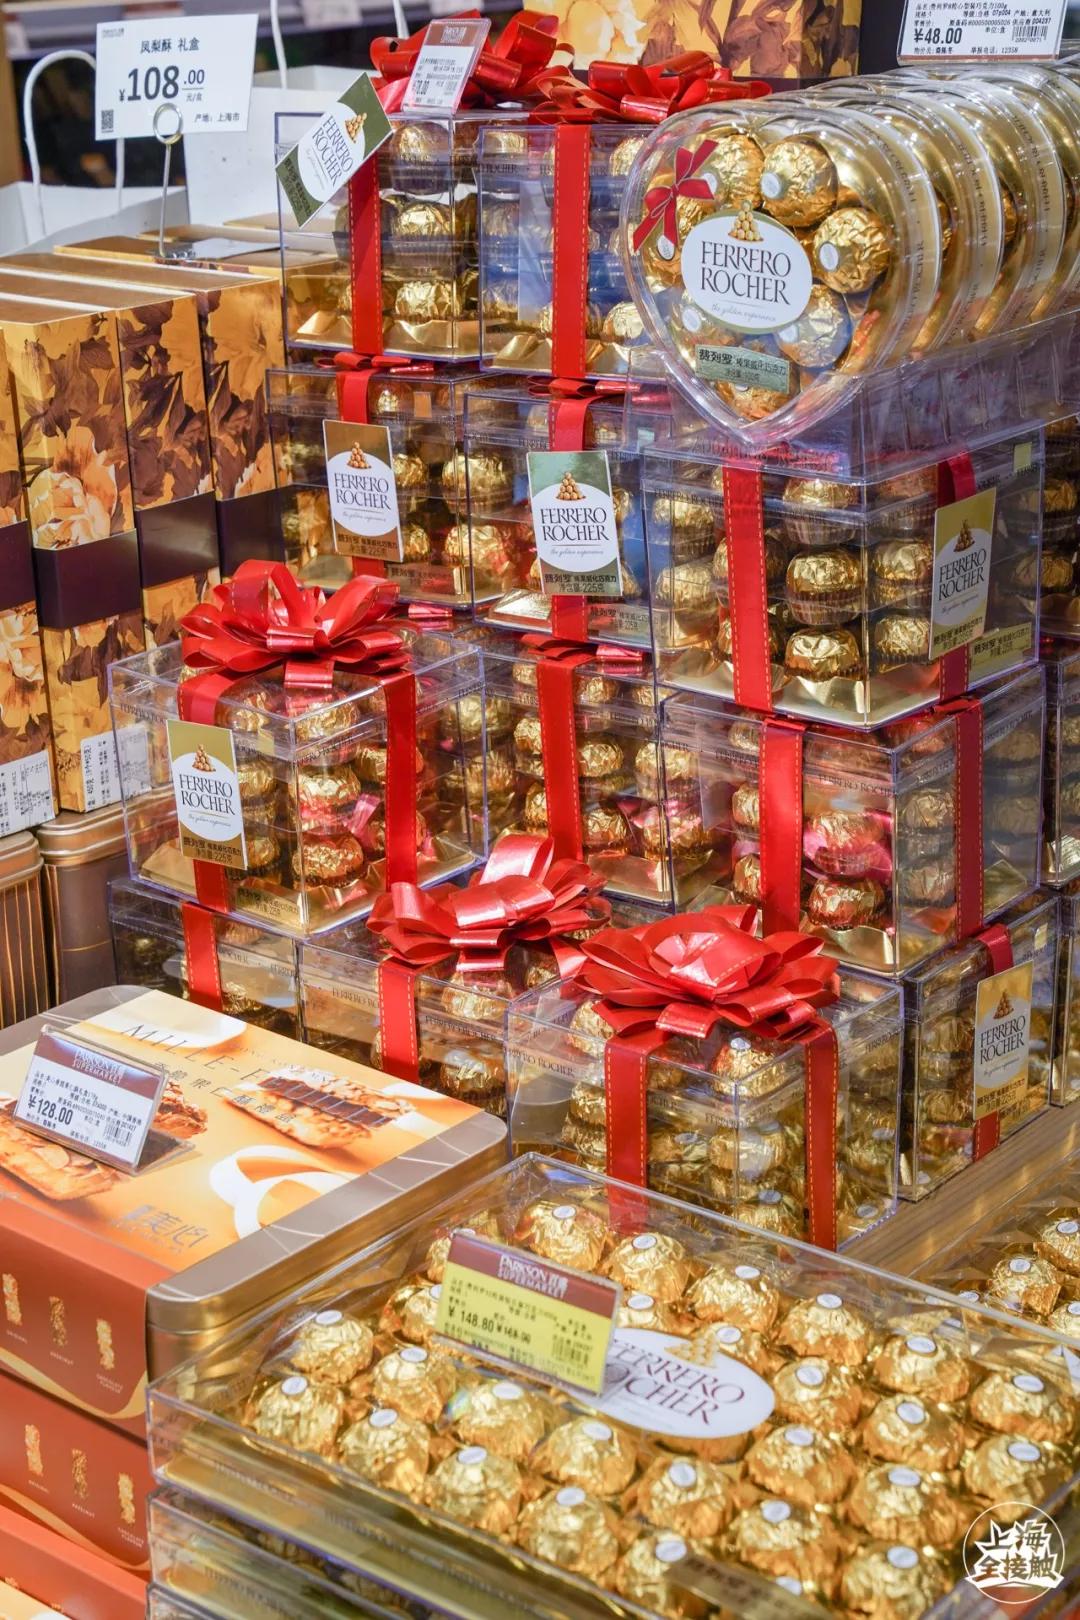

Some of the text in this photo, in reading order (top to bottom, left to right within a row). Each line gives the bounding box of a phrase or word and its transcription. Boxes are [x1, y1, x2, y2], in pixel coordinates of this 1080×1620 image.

[140, 37, 200, 54] 凤梨酥 礼盒
[914, 27, 963, 45] ¥48.00
[312, 127, 343, 187] ROCHER
[323, 115, 354, 173] FERRERO
[701, 240, 792, 278] FERRERO
[701, 266, 791, 306] ROCHER
[334, 472, 389, 494] FERRERO
[336, 488, 391, 510] ROCHER
[540, 507, 607, 524] FERRERO
[543, 525, 610, 542] ROCHER
[939, 548, 987, 583] FERRERO
[938, 566, 985, 601] ROCHER
[179, 773, 233, 799] FERRERO
[181, 791, 235, 816] ROCHER
[980, 1015, 1026, 1048] FERRERO
[980, 1032, 1025, 1064] ROCHER
[28, 1094, 73, 1126] ¥128.00
[498, 1254, 548, 1281] PARKSON
[496, 1268, 566, 1299] SUPERMARKET
[606, 1363, 720, 1426] OCHER
